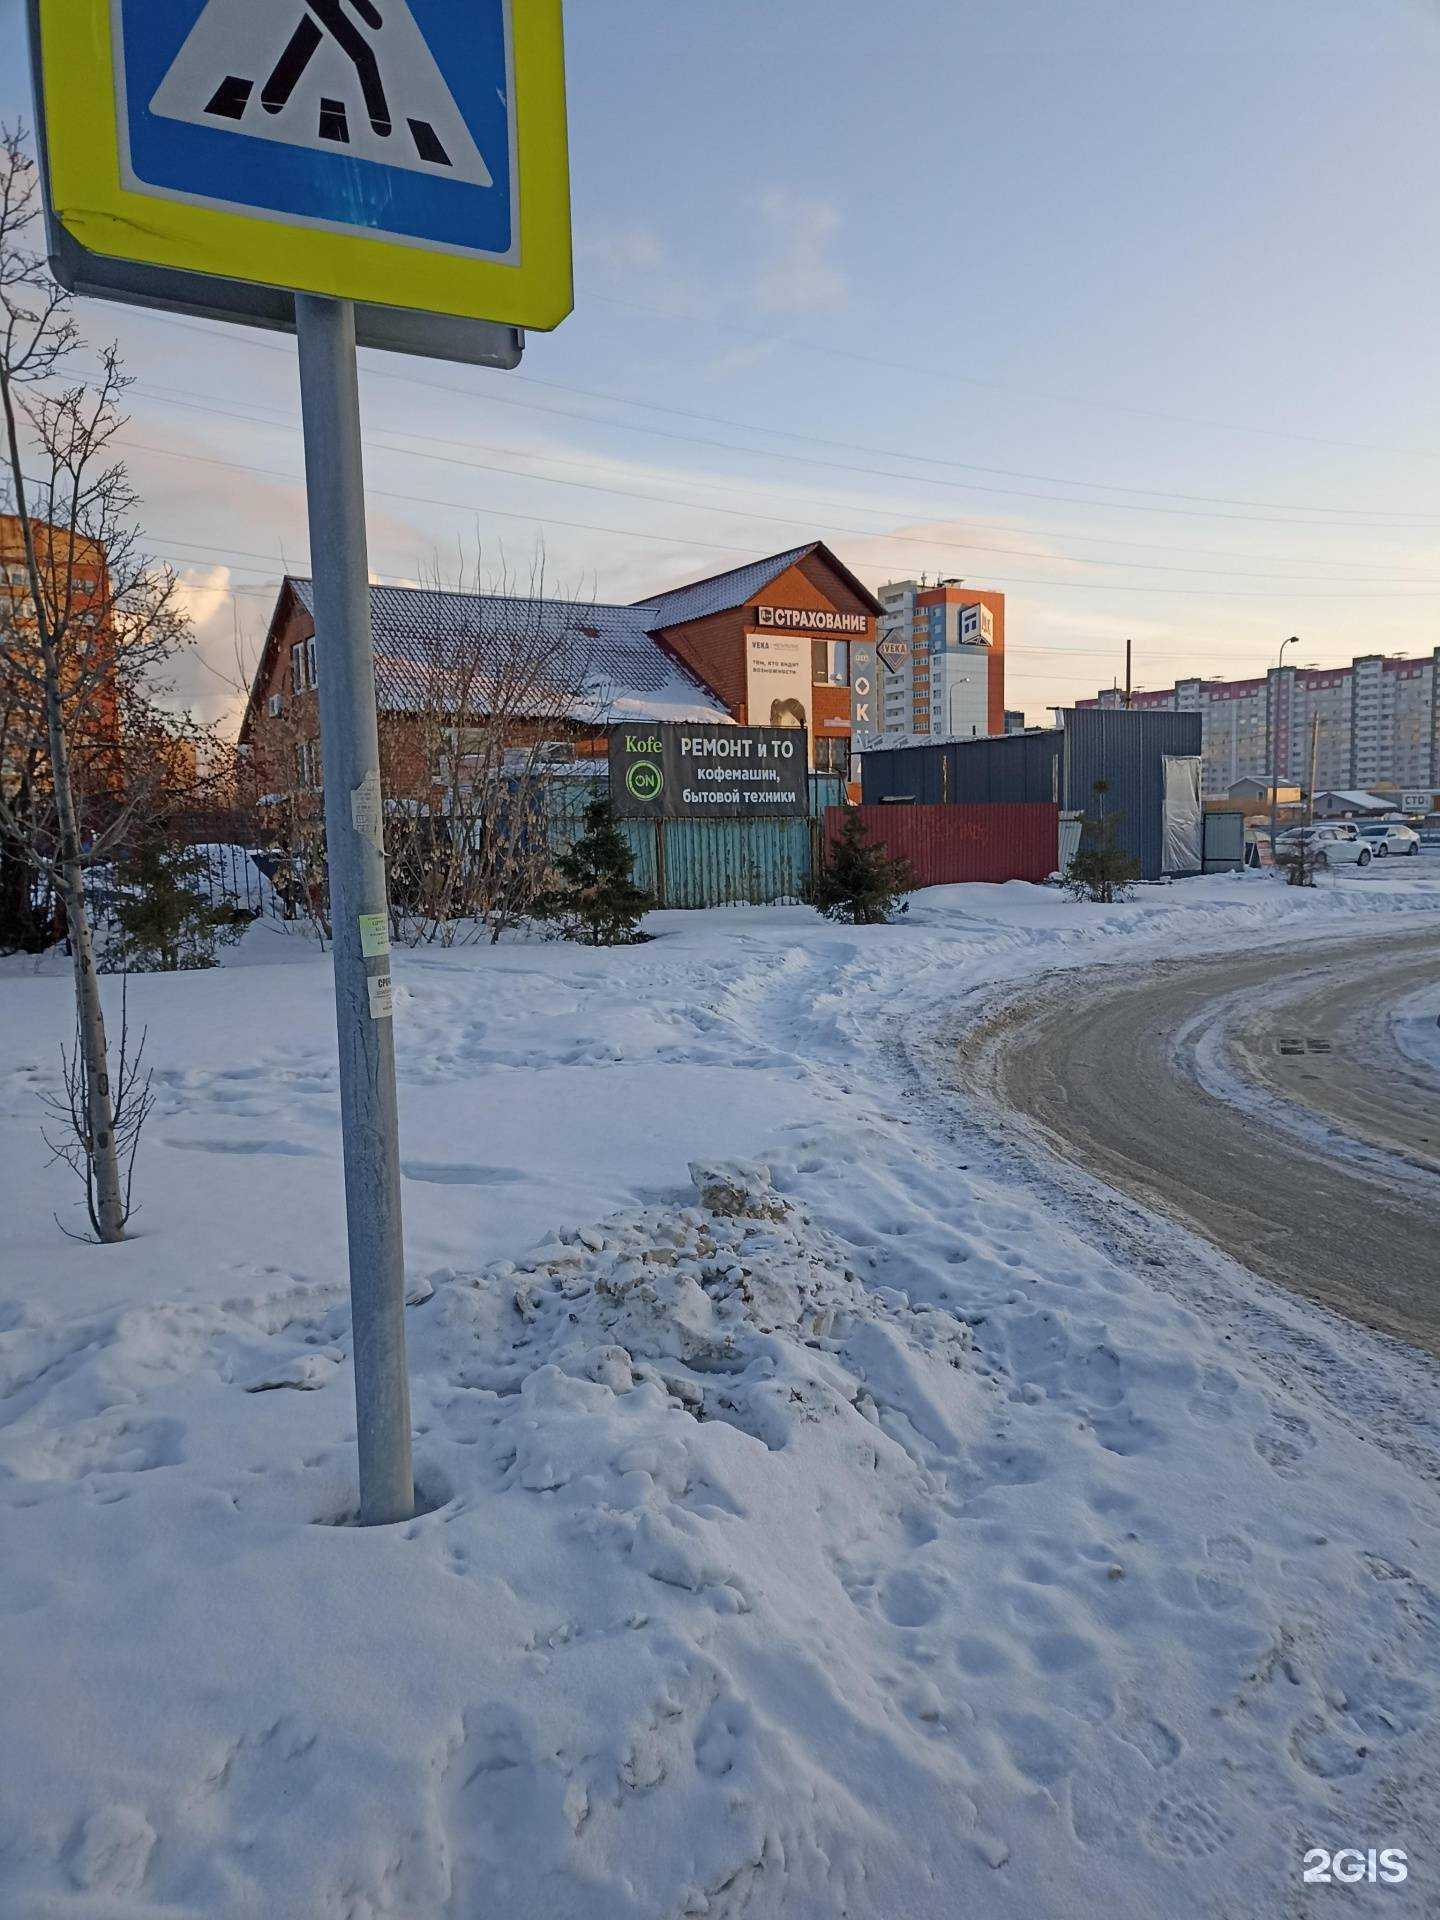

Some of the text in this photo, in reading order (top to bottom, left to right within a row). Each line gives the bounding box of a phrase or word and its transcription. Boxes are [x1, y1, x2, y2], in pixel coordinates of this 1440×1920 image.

[775, 609, 866, 631] СТРАХОВАНИЕ
[752, 641, 769, 649] VEKA
[884, 644, 905, 653] VEKA
[625, 735, 663, 753] Kofe
[681, 738, 794, 758] РЕМОНТ и ТО
[635, 776, 655, 787] ON
[697, 766, 780, 783] кофемашин,
[682, 789, 796, 803] бытовой техники
